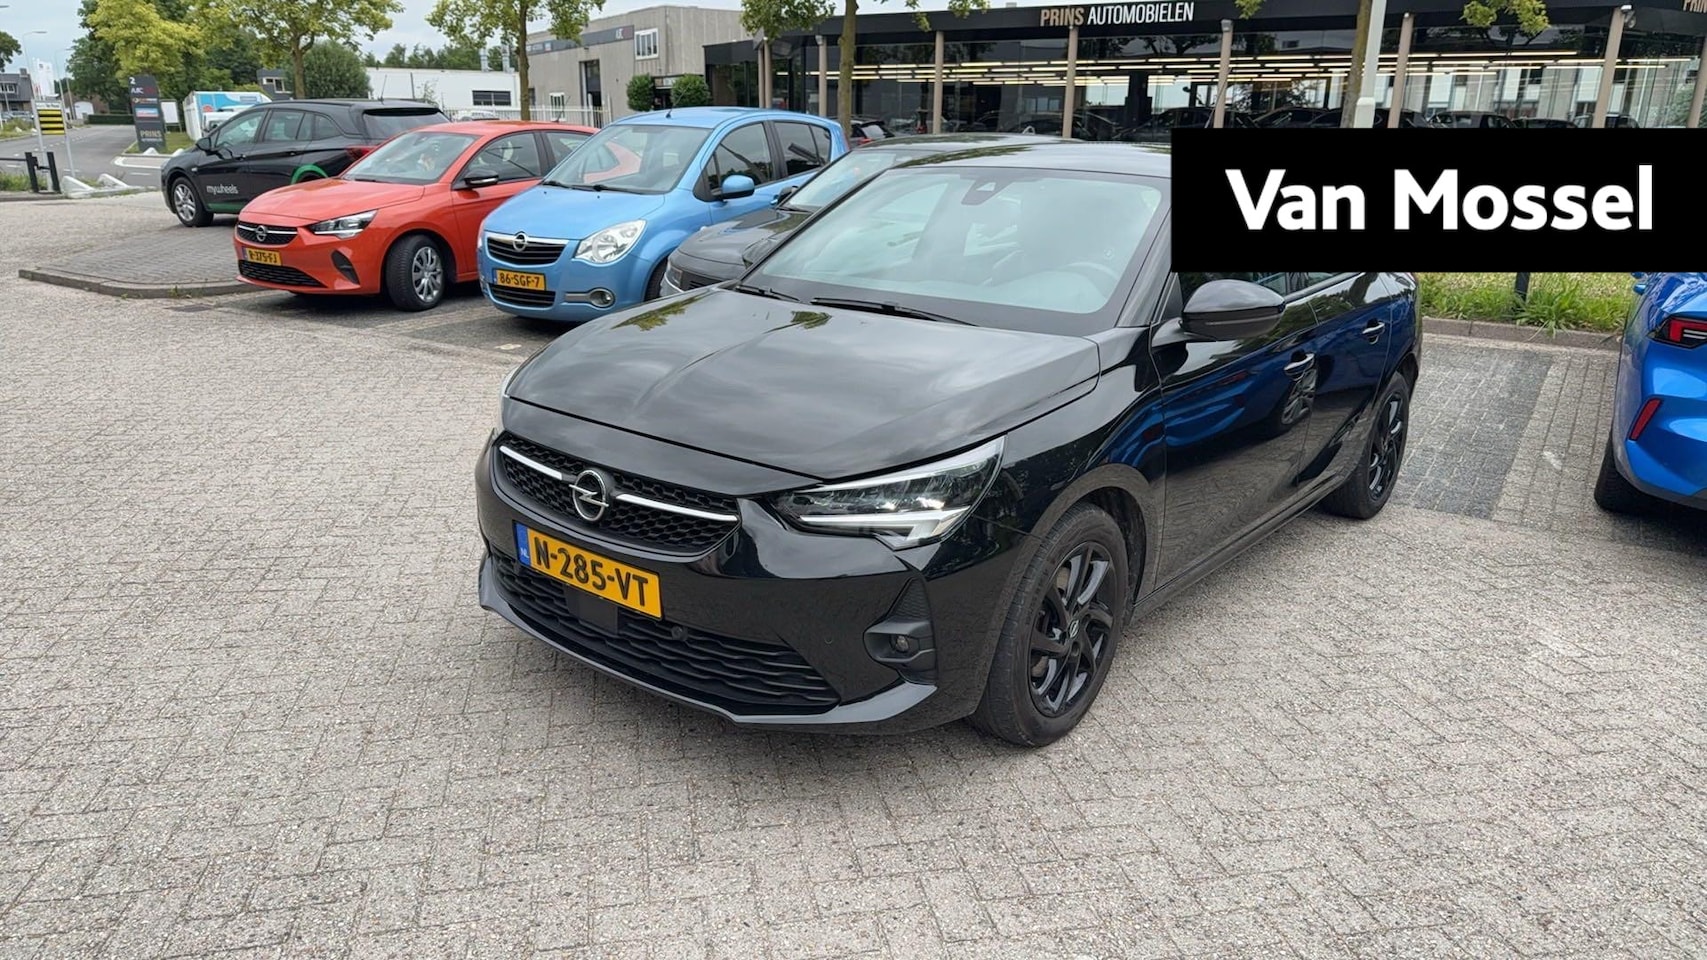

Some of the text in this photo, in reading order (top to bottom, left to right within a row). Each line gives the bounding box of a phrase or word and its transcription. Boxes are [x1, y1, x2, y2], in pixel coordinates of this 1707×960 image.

[1040, 2, 1194, 27] PRINS AUTOMOBIELEN
[129, 76, 136, 85] 2
[140, 130, 162, 138] PRINS
[206, 183, 239, 195] mywheels
[499, 271, 540, 288] 86-SGF-7
[534, 536, 648, 607] N-285-VT
